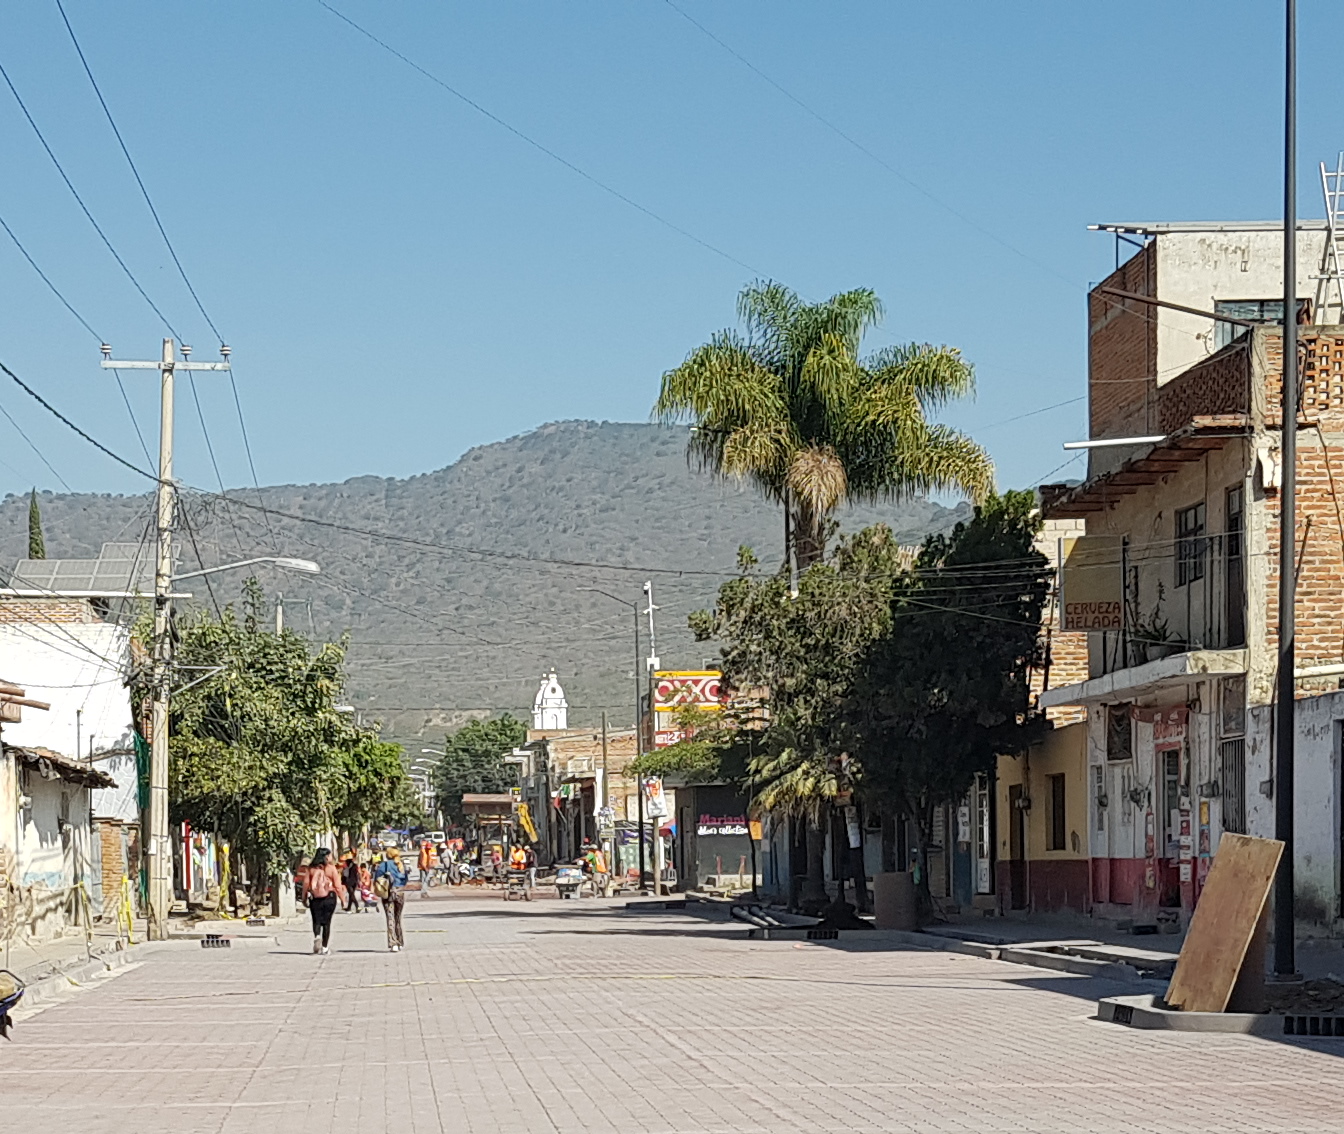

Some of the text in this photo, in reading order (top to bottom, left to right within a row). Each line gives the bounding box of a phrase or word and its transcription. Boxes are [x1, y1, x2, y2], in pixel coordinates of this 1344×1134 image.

[1066, 601, 1121, 615] CERVEZA
[1066, 615, 1121, 629] HELADA
[654, 679, 721, 706] OXXO
